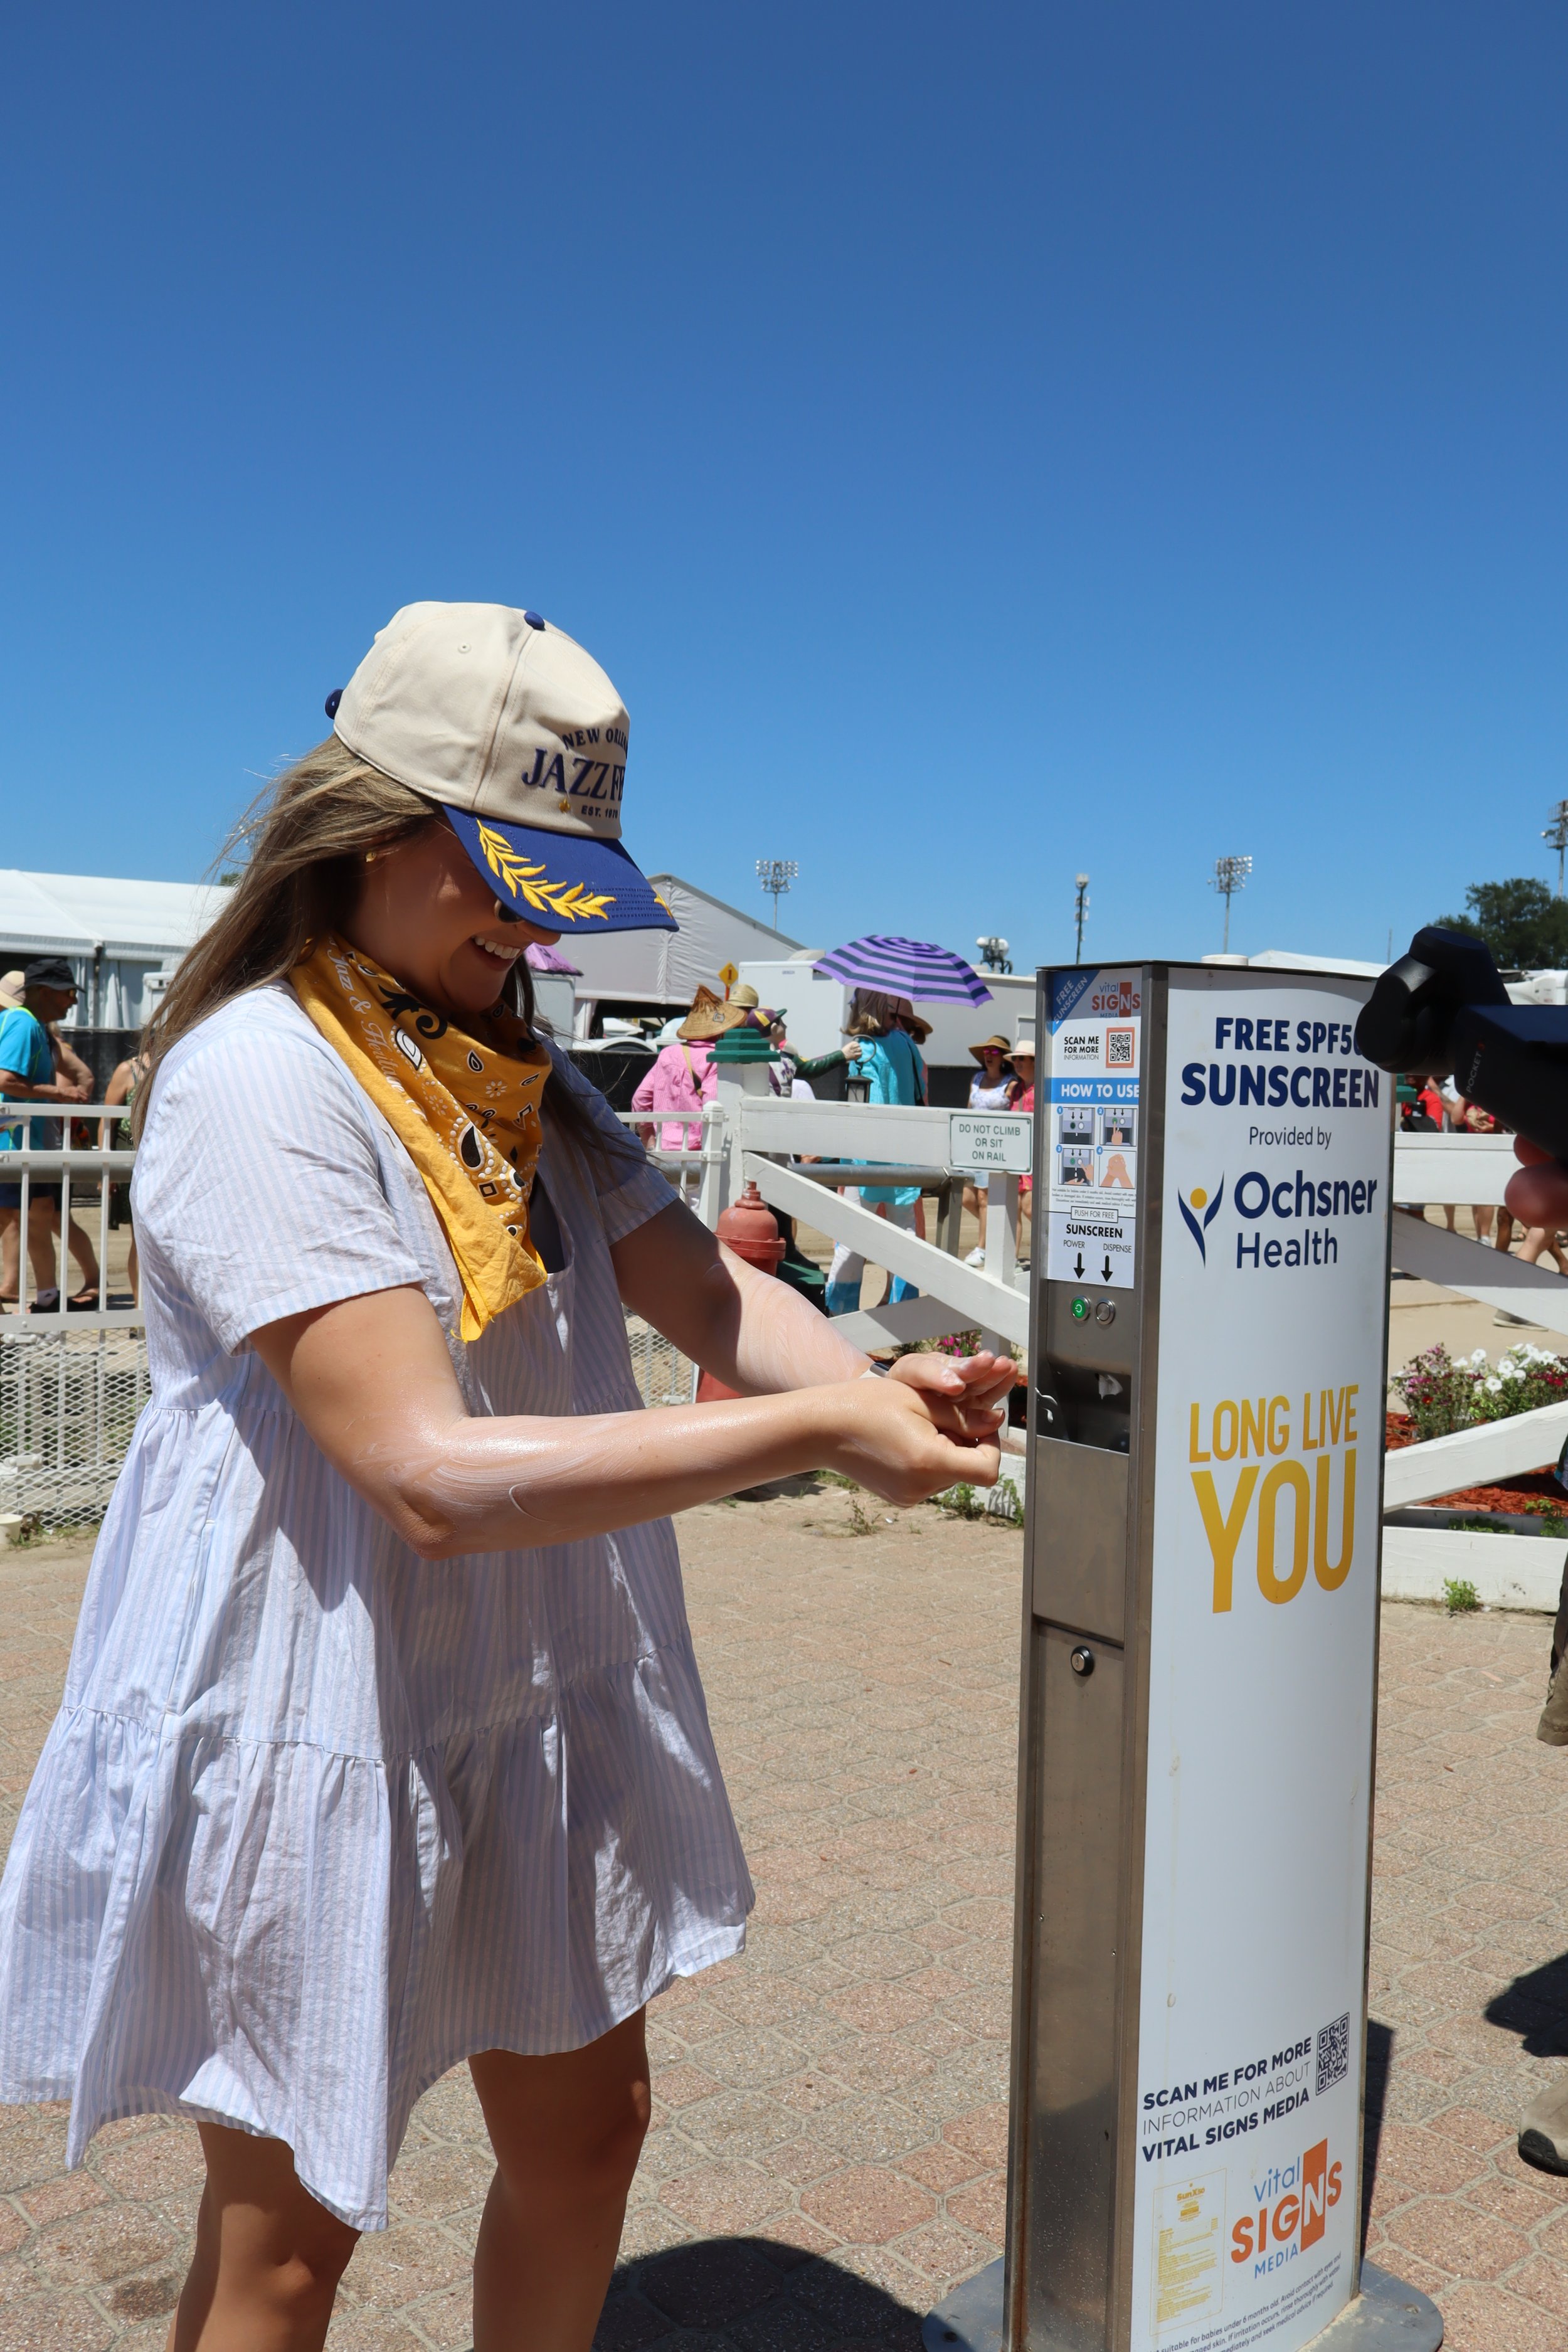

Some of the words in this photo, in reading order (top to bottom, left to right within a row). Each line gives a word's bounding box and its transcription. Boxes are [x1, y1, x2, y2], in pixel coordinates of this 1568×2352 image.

[562, 728, 600, 751] NEW
[521, 748, 610, 800] JAZZ
[581, 805, 601, 817] EST.
[1054, 977, 1088, 1024] SUNSCREEN
[1056, 980, 1075, 1005] FREE
[1092, 993, 1141, 1010] SIGNS
[1099, 982, 1118, 992] vital
[349, 995, 371, 1015] &
[1088, 1036, 1099, 1044] ME
[1216, 1017, 1290, 1051] FREE
[1181, 1062, 1379, 1108] SUNSCREEN
[1466, 1051, 1481, 1093] POCKET
[1061, 1084, 1093, 1098] HOW
[1096, 1084, 1113, 1098] TO
[1117, 1084, 1140, 1098] USE
[959, 1124, 971, 1133] DO
[973, 1125, 991, 1134] NOT
[993, 1126, 1020, 1136] CLIMB
[975, 1138, 987, 1147] OR
[990, 1139, 1003, 1148] SIT
[1249, 1126, 1313, 1145] Provided
[1317, 1126, 1332, 1150] by
[972, 1151, 984, 1160] ON
[987, 1152, 1006, 1162] RAIL
[1234, 1170, 1377, 1219] Ochsner
[1064, 1240, 1085, 1249] POWER
[1103, 1243, 1132, 1253] DISPENSE
[1066, 1224, 1123, 1238] SUNSCREEN
[1237, 1228, 1338, 1269] Health
[1189, 1396, 1290, 1463] LONG
[1303, 1384, 1359, 1451] LIVE
[1190, 1448, 1356, 1613] YOU
[1143, 2082, 1197, 2110] SCAN
[1203, 2072, 1229, 2095] ME
[1234, 2059, 1267, 2085] FOR
[1272, 2037, 1311, 2070] MORE
[1144, 2086, 1260, 2135] INFORMATION
[1266, 2061, 1311, 2097] ABOUT
[1142, 2133, 1200, 2162] VITAL
[1205, 2112, 1258, 2145] SIGNS
[1263, 2087, 1310, 2124] MEDIA
[1254, 2156, 1300, 2202] vital
[1231, 2161, 1342, 2263] SIGNS
[1254, 2243, 1298, 2279] MEDIA
[1162, 2340, 1189, 2352] suitable
[1190, 2336, 1200, 2344] for
[1202, 2328, 1222, 2341] babies
[1224, 2319, 1242, 2332] under
[1242, 2315, 1247, 2323] 6
[1248, 2306, 1269, 2321] months
[1281, 2287, 1295, 2303] Avoid
[1212, 2338, 1227, 2348] skin.
[1228, 2332, 1233, 2341] If
[1234, 2322, 1260, 2339] irritation
[1251, 2330, 1263, 2342] and
[1263, 2323, 1275, 2336] seek
[1276, 2309, 1296, 2328] medical
